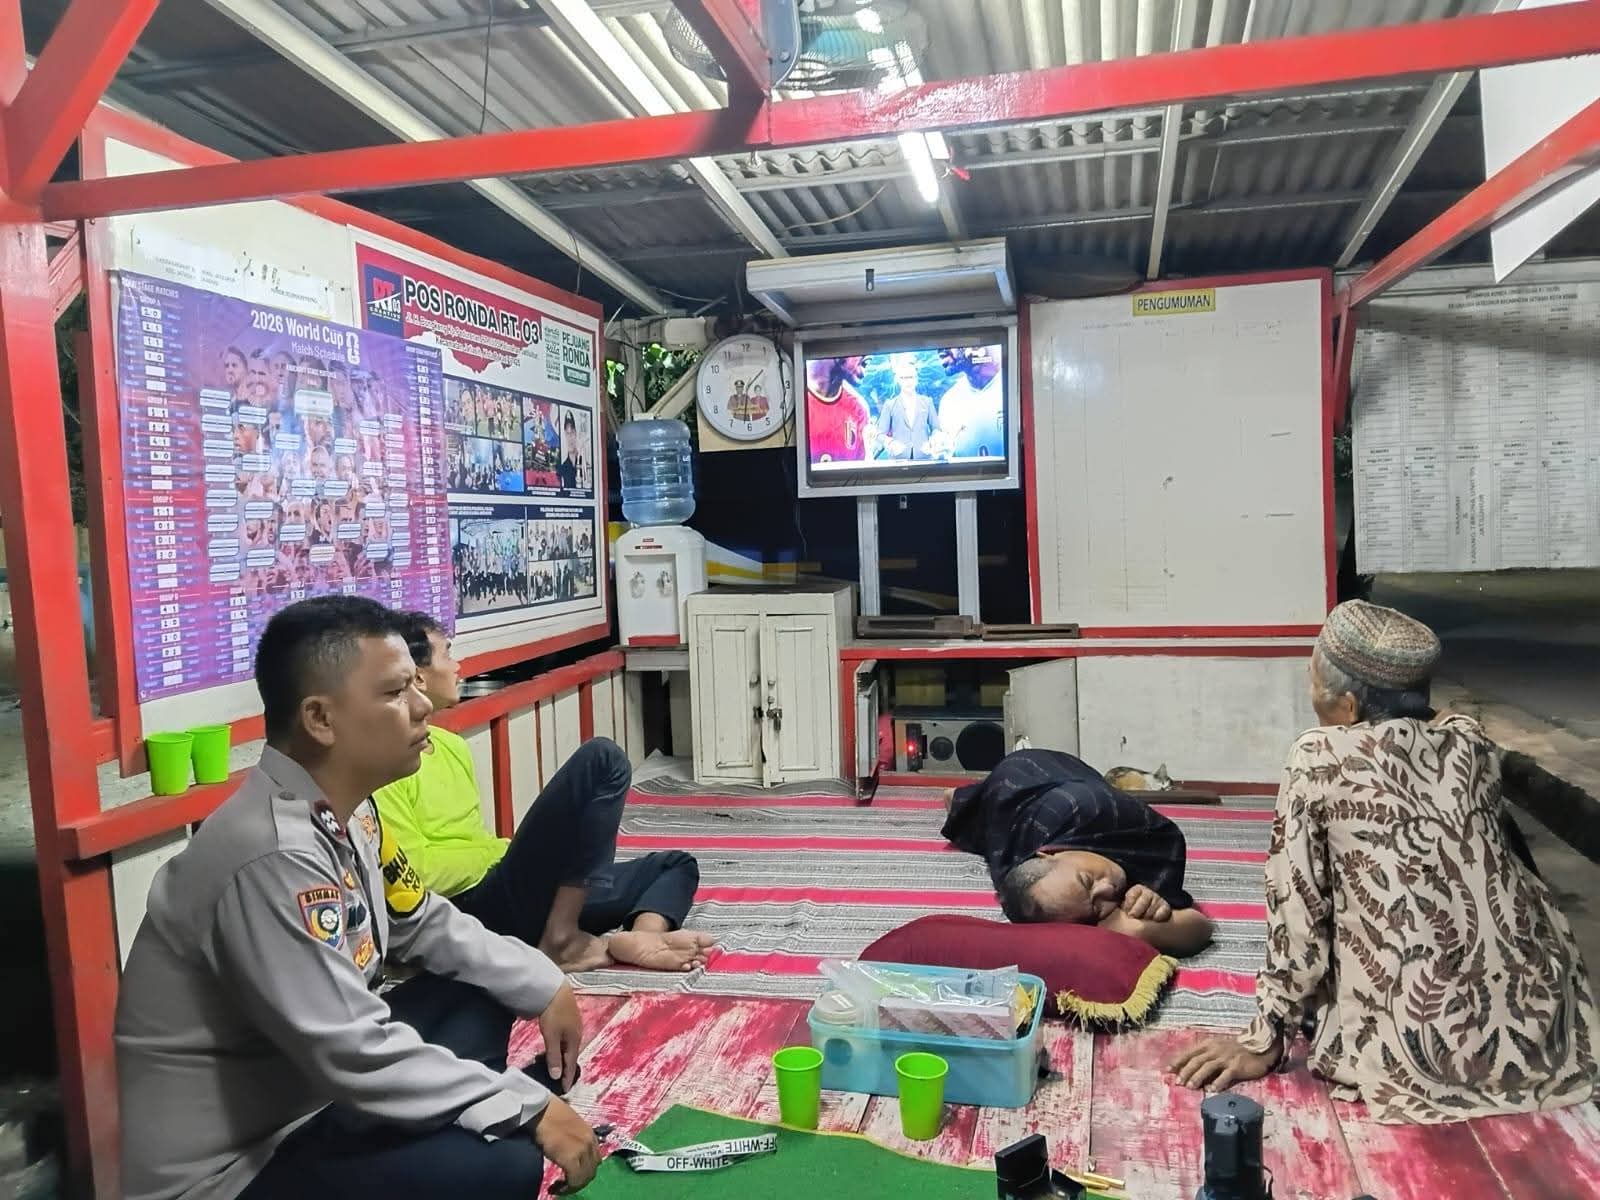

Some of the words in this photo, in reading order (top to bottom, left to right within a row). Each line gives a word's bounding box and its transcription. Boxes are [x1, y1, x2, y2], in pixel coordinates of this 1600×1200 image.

[1137, 294, 1211, 311] PENGUMUMAN
[404, 277, 441, 313] POS
[443, 290, 498, 331] RONDA
[522, 321, 540, 345] 03
[250, 309, 284, 334] 2026
[286, 316, 321, 342] World
[322, 326, 344, 350] Cup
[562, 331, 590, 352] PEJUANG
[291, 341, 314, 357] Match
[314, 346, 345, 363] Schedule
[741, 343, 750, 352] 12
[562, 346, 590, 368] RONDA
[724, 351, 731, 360] 11
[711, 365, 720, 374] 10
[705, 385, 711, 394] 9
[785, 380, 791, 390] 3
[713, 405, 718, 414] 8
[729, 419, 734, 428] 7
[747, 422, 752, 431] 6
[765, 417, 771, 426] 5
[725, 1137, 777, 1153] FF-WHITE
[666, 1157, 729, 1170] OFF-WHITE
